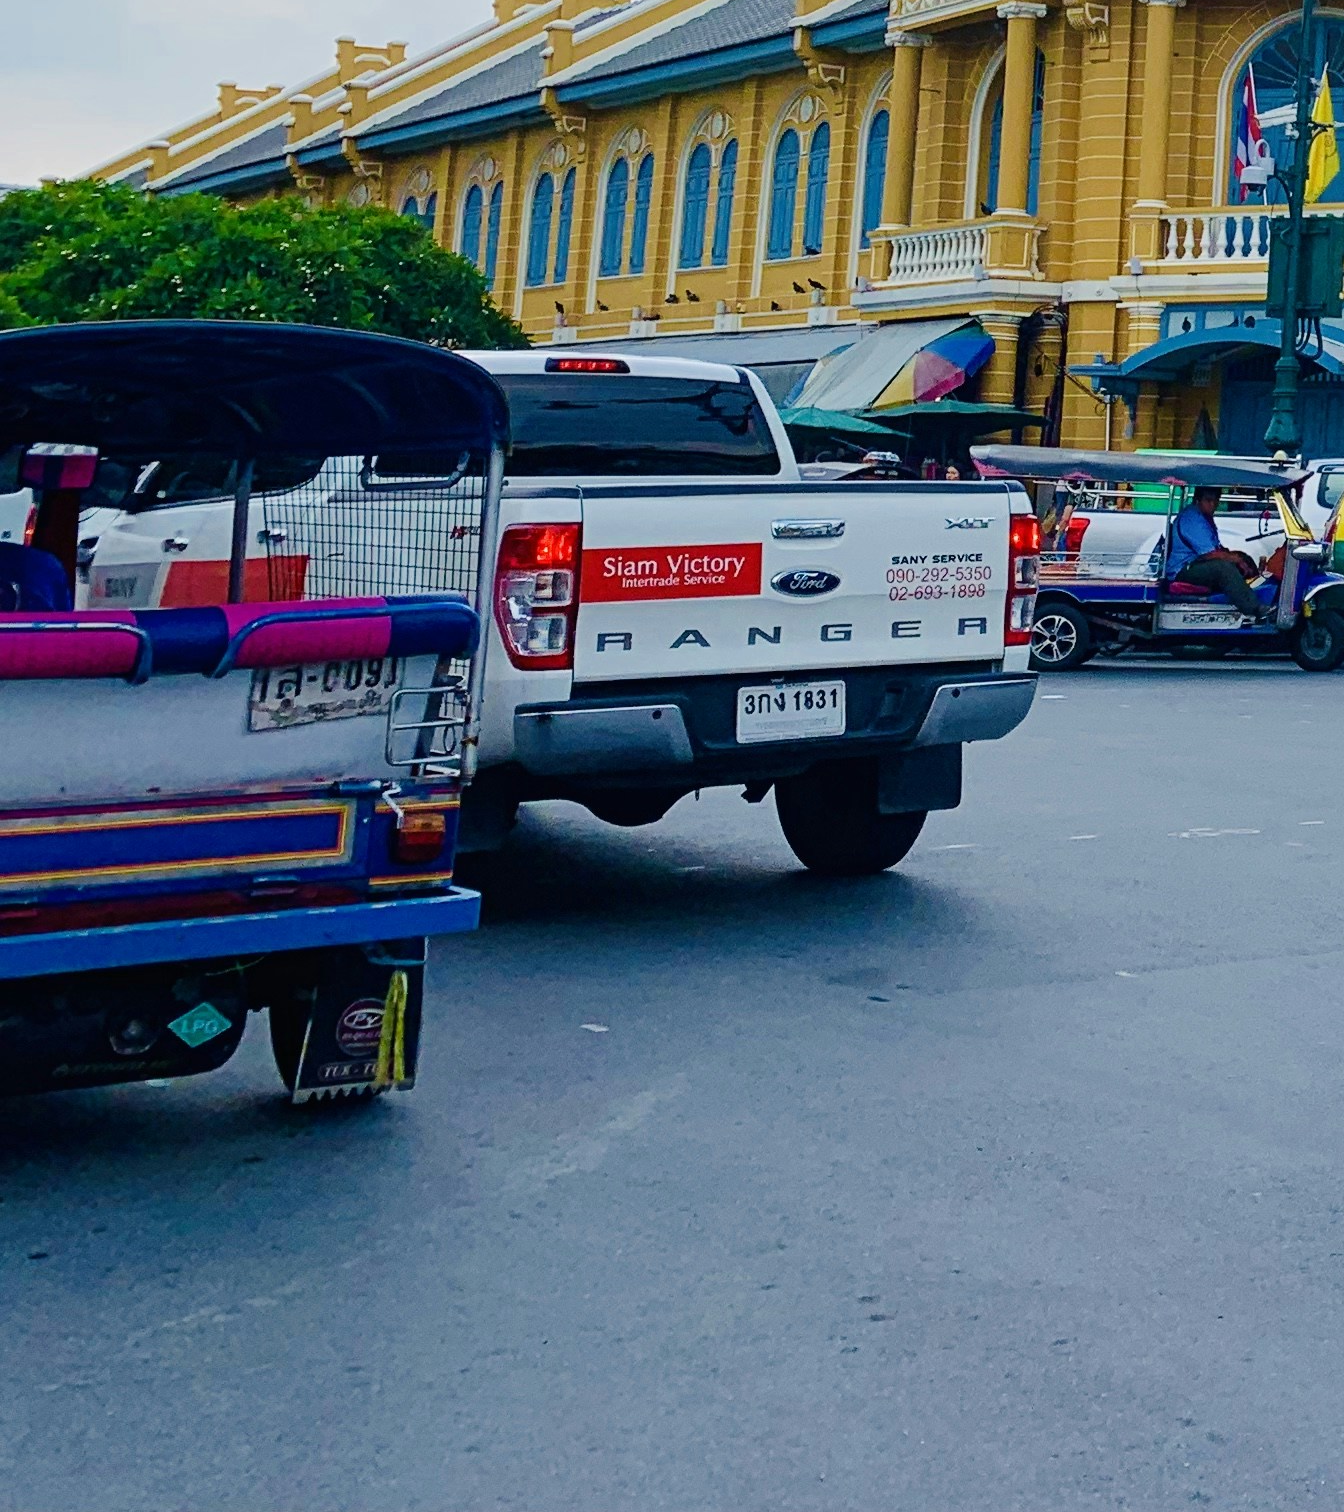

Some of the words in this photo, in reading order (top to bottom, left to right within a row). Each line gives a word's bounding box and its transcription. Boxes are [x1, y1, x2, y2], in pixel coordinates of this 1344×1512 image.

[603, 555, 658, 578] Siam
[666, 553, 746, 578] Victory
[891, 554, 928, 565] SANY
[932, 552, 983, 564] SERVICE
[622, 574, 680, 589] Intertrade
[683, 573, 726, 587] Service
[789, 571, 828, 590] Ford
[885, 565, 992, 584] 090-292-5350
[888, 582, 987, 602] 02-693-1898
[596, 616, 988, 653] RANGER
[744, 691, 787, 715] 3กง
[793, 688, 838, 712] 1831
[179, 1019, 219, 1035] LPG
